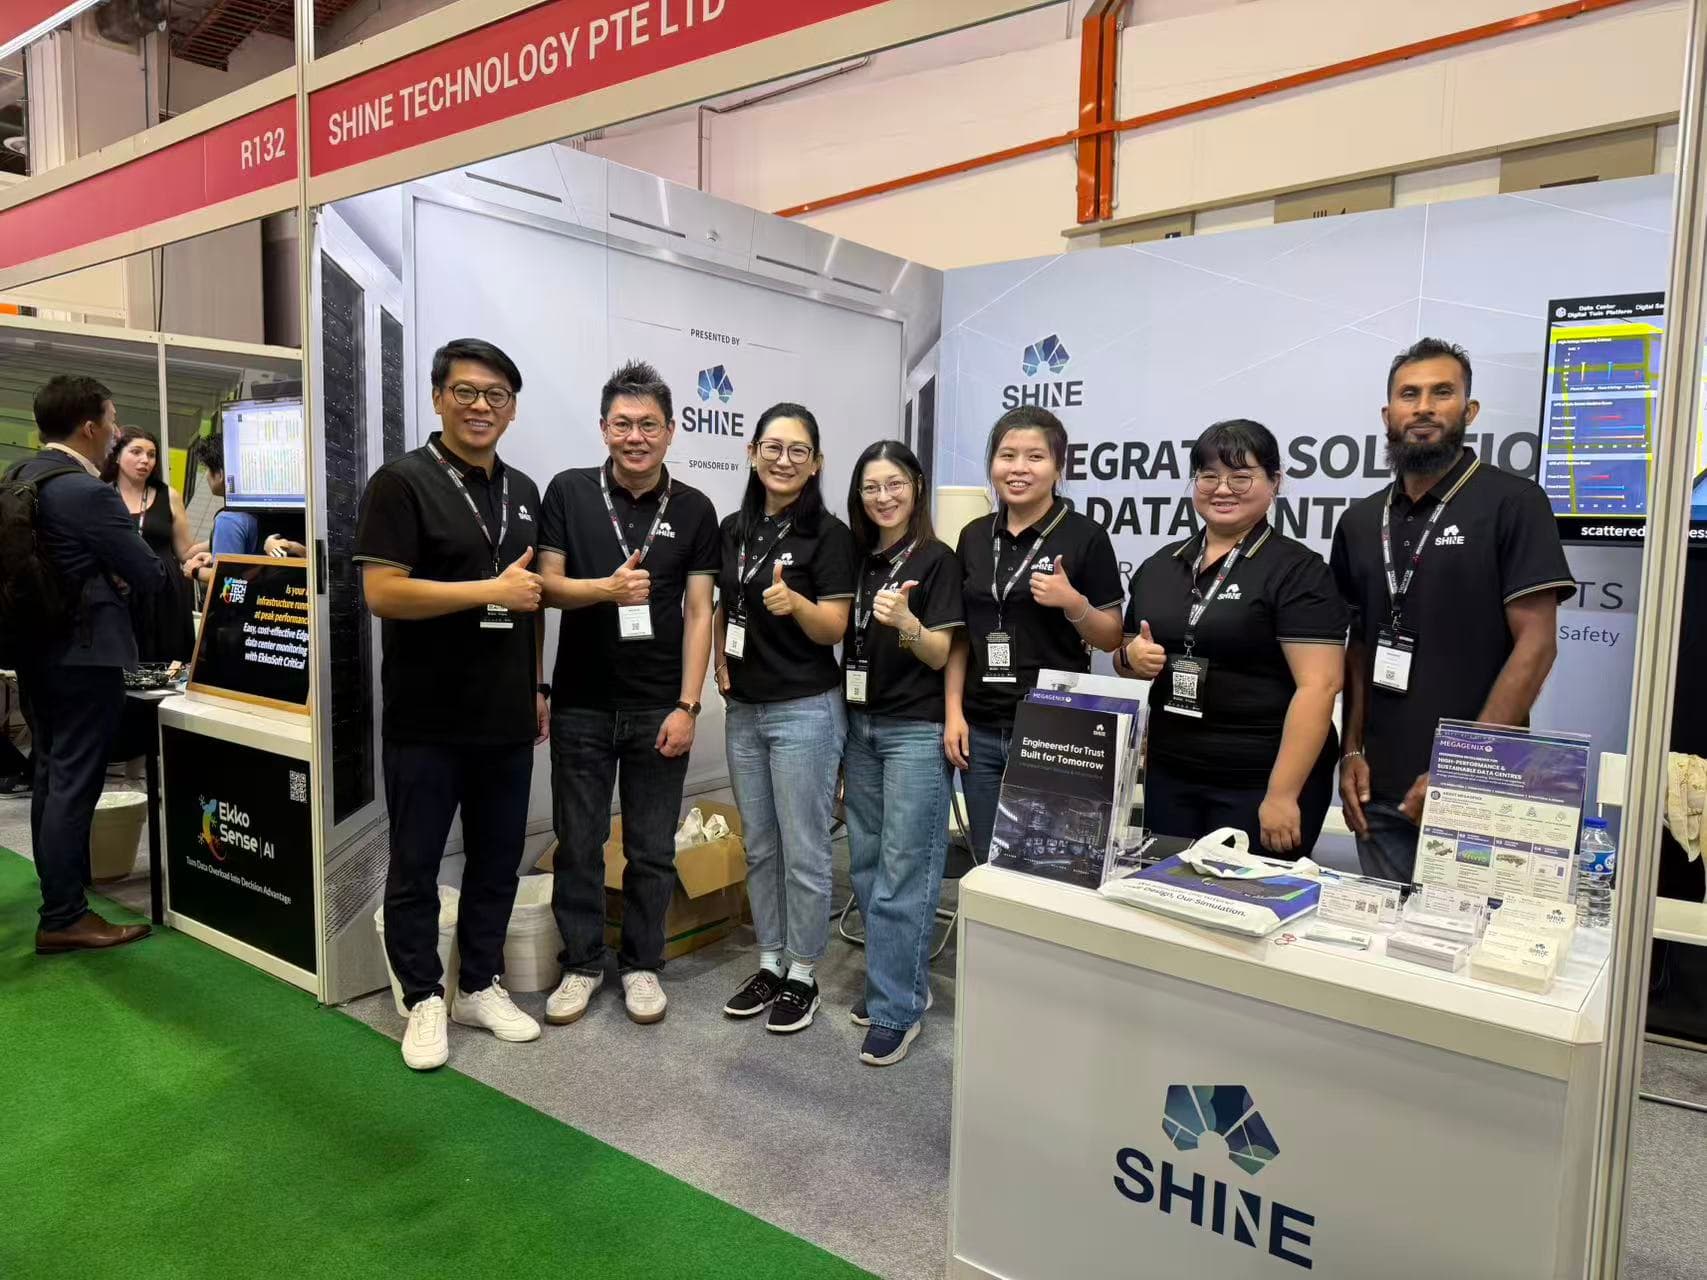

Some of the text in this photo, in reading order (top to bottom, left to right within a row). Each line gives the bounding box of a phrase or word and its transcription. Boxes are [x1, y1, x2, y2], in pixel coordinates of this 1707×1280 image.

[328, 96, 394, 146] SHINE
[399, 27, 580, 121] TECHNOLOGY
[589, 1, 650, 61] PTE
[240, 127, 286, 170] R132
[690, 329, 740, 346] PRESENTED BY
[1002, 380, 1084, 411] SHINE
[681, 406, 744, 437] SHINE
[688, 460, 739, 471] SPONSORED BY
[1086, 497, 1199, 536] DATA
[1435, 536, 1465, 546] SHINE
[1581, 525, 1645, 537] scattered
[229, 593, 244, 603] TIPS
[231, 584, 247, 594] TECH
[257, 626, 295, 639] cost-effective
[1559, 625, 1621, 647] Safety
[245, 637, 308, 657] data center monitoring
[245, 651, 257, 661] with
[283, 657, 305, 670] Critical
[1022, 737, 1105, 758] Engineered for Trust
[1439, 740, 1485, 752] MEGAGENIX
[1020, 748, 1041, 760] Built
[1042, 752, 1056, 762] for
[1057, 754, 1104, 770] Tomorrow
[218, 801, 250, 828] Ekko
[219, 825, 275, 860] Sense AI
[241, 876, 263, 894] Decision
[263, 886, 291, 905] Advantage
[1113, 1147, 1316, 1270] SHINE
